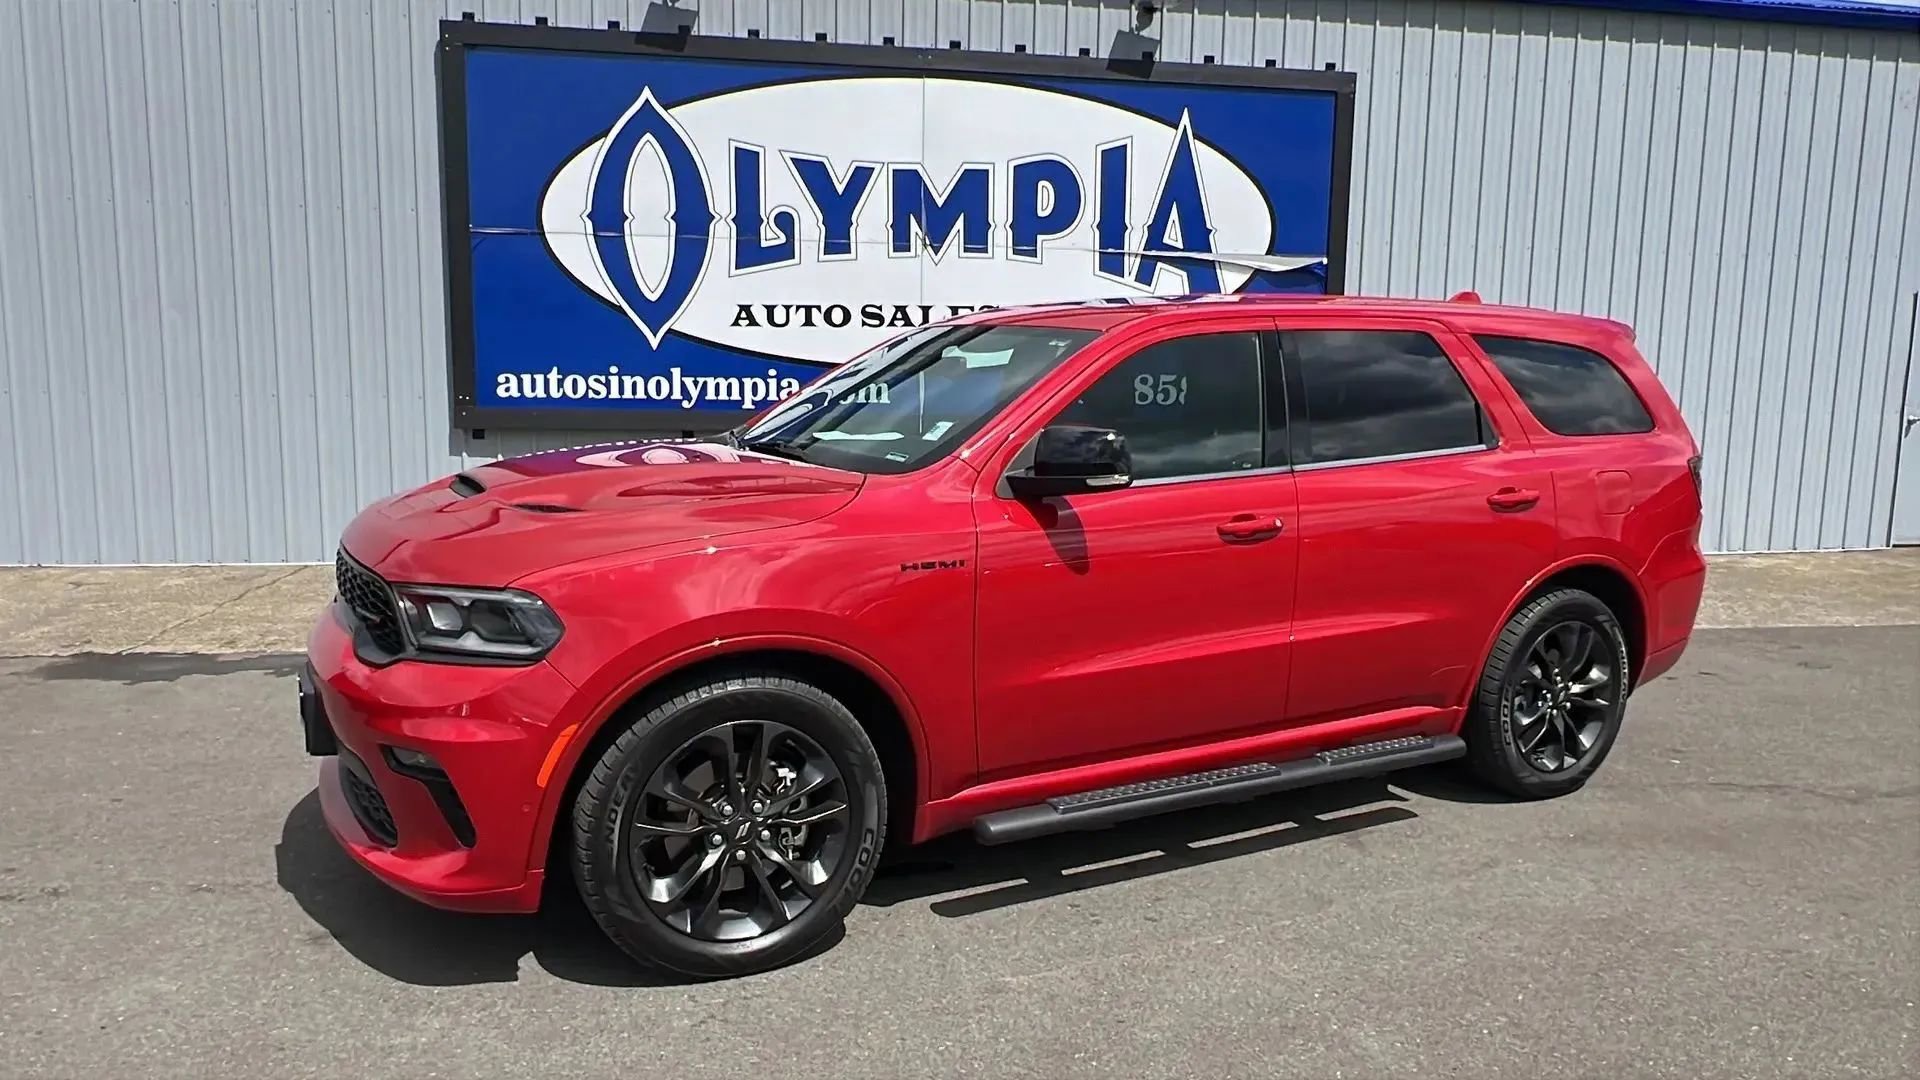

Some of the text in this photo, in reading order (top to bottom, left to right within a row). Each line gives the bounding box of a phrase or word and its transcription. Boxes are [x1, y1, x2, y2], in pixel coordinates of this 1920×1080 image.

[580, 86, 1227, 350] OLYMPIA
[730, 303, 1000, 328] AUTO SAL
[496, 365, 891, 409] autosinolympiam
[900, 560, 965, 572] HEMI
